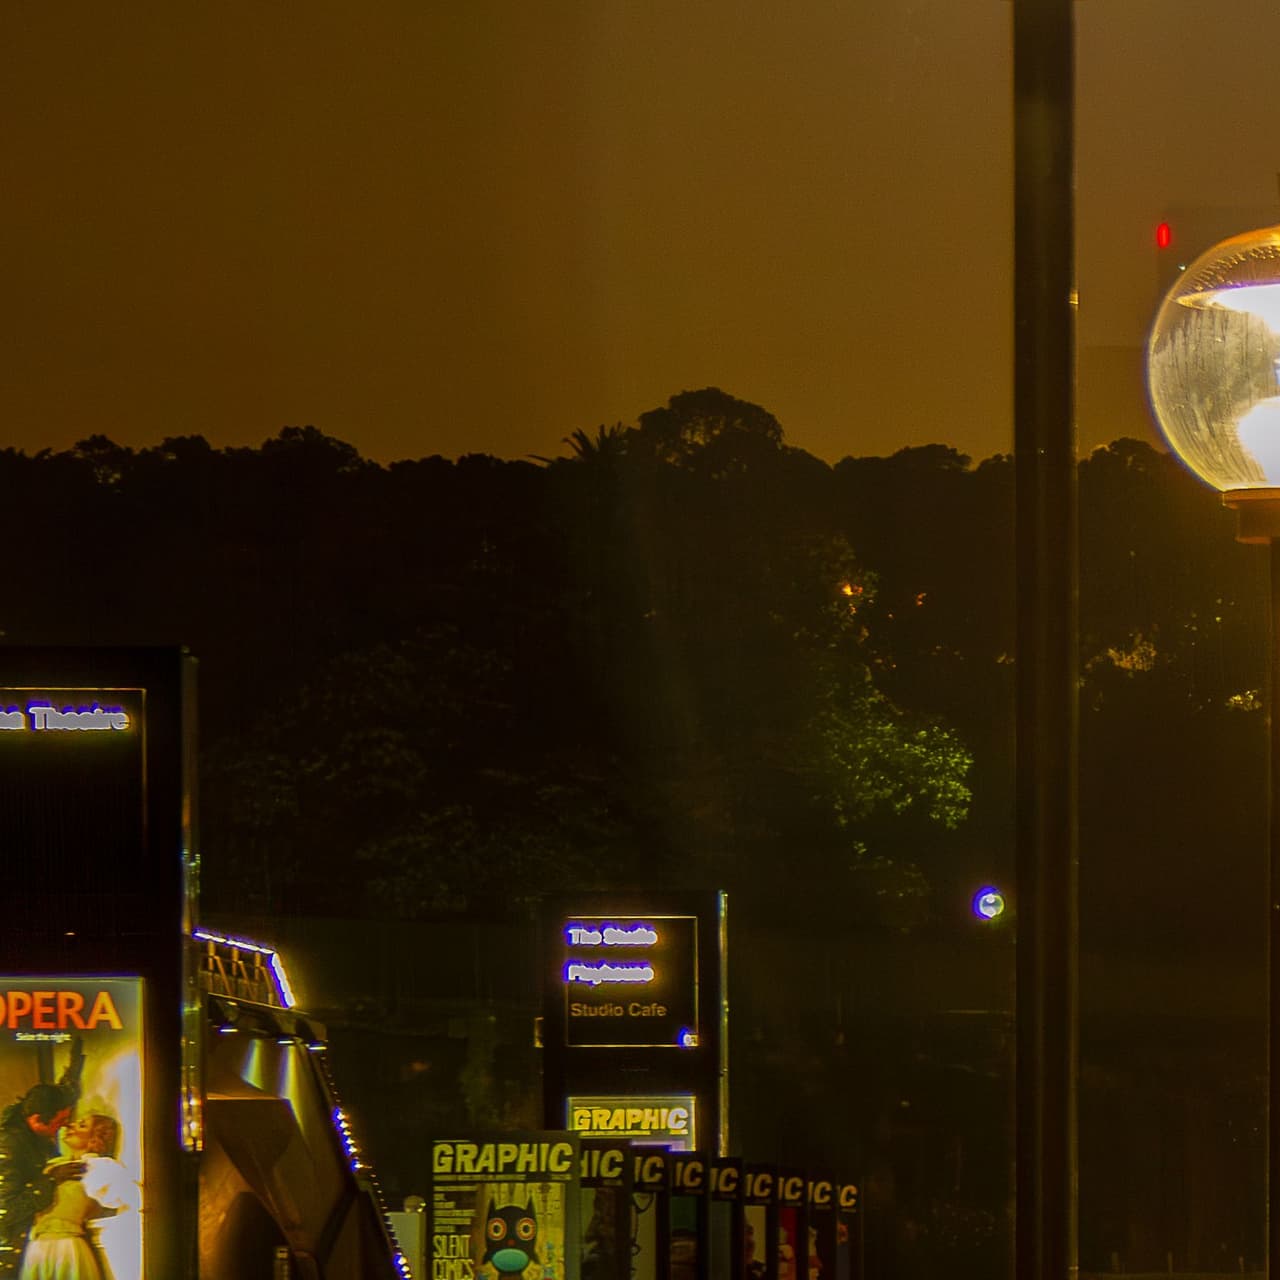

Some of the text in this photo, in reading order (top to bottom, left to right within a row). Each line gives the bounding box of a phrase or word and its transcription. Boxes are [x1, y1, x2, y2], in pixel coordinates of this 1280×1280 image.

[567, 928, 602, 945] The
[0, 991, 123, 1030] PERA
[570, 1002, 668, 1017] Studio Cafe
[573, 1107, 688, 1131] GRAPHIC
[433, 1142, 573, 1173] GRAPHIC
[432, 1234, 472, 1259] SILENT
